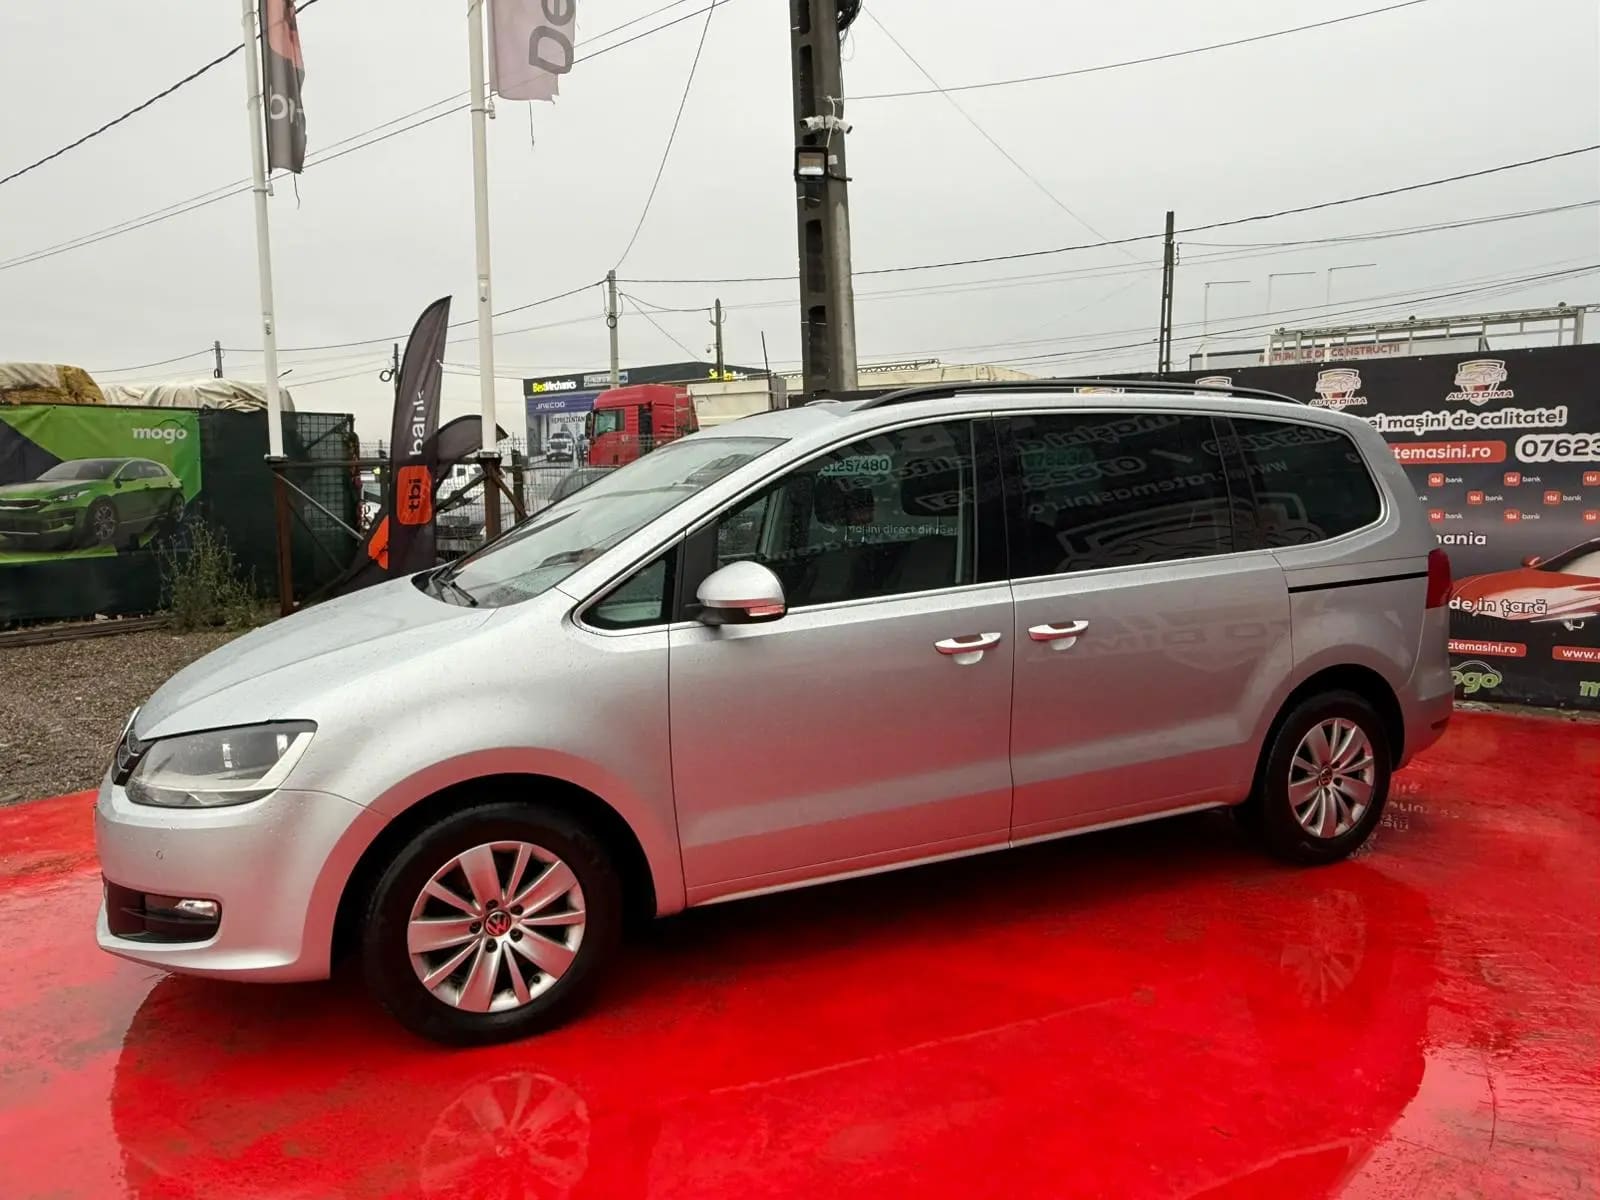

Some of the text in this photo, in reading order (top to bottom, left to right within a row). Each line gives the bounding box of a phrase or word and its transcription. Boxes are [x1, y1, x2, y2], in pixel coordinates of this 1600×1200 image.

[1311, 397, 1367, 407] AUTO DIMA
[1449, 390, 1512, 400] AUTO DIMA
[1387, 414, 1446, 433] mașini
[1453, 413, 1475, 427] de
[1480, 409, 1564, 426] calitate!
[132, 427, 188, 444] mogo
[408, 477, 422, 513] tbi
[1478, 597, 1496, 612] in
[1500, 599, 1548, 616] țară
